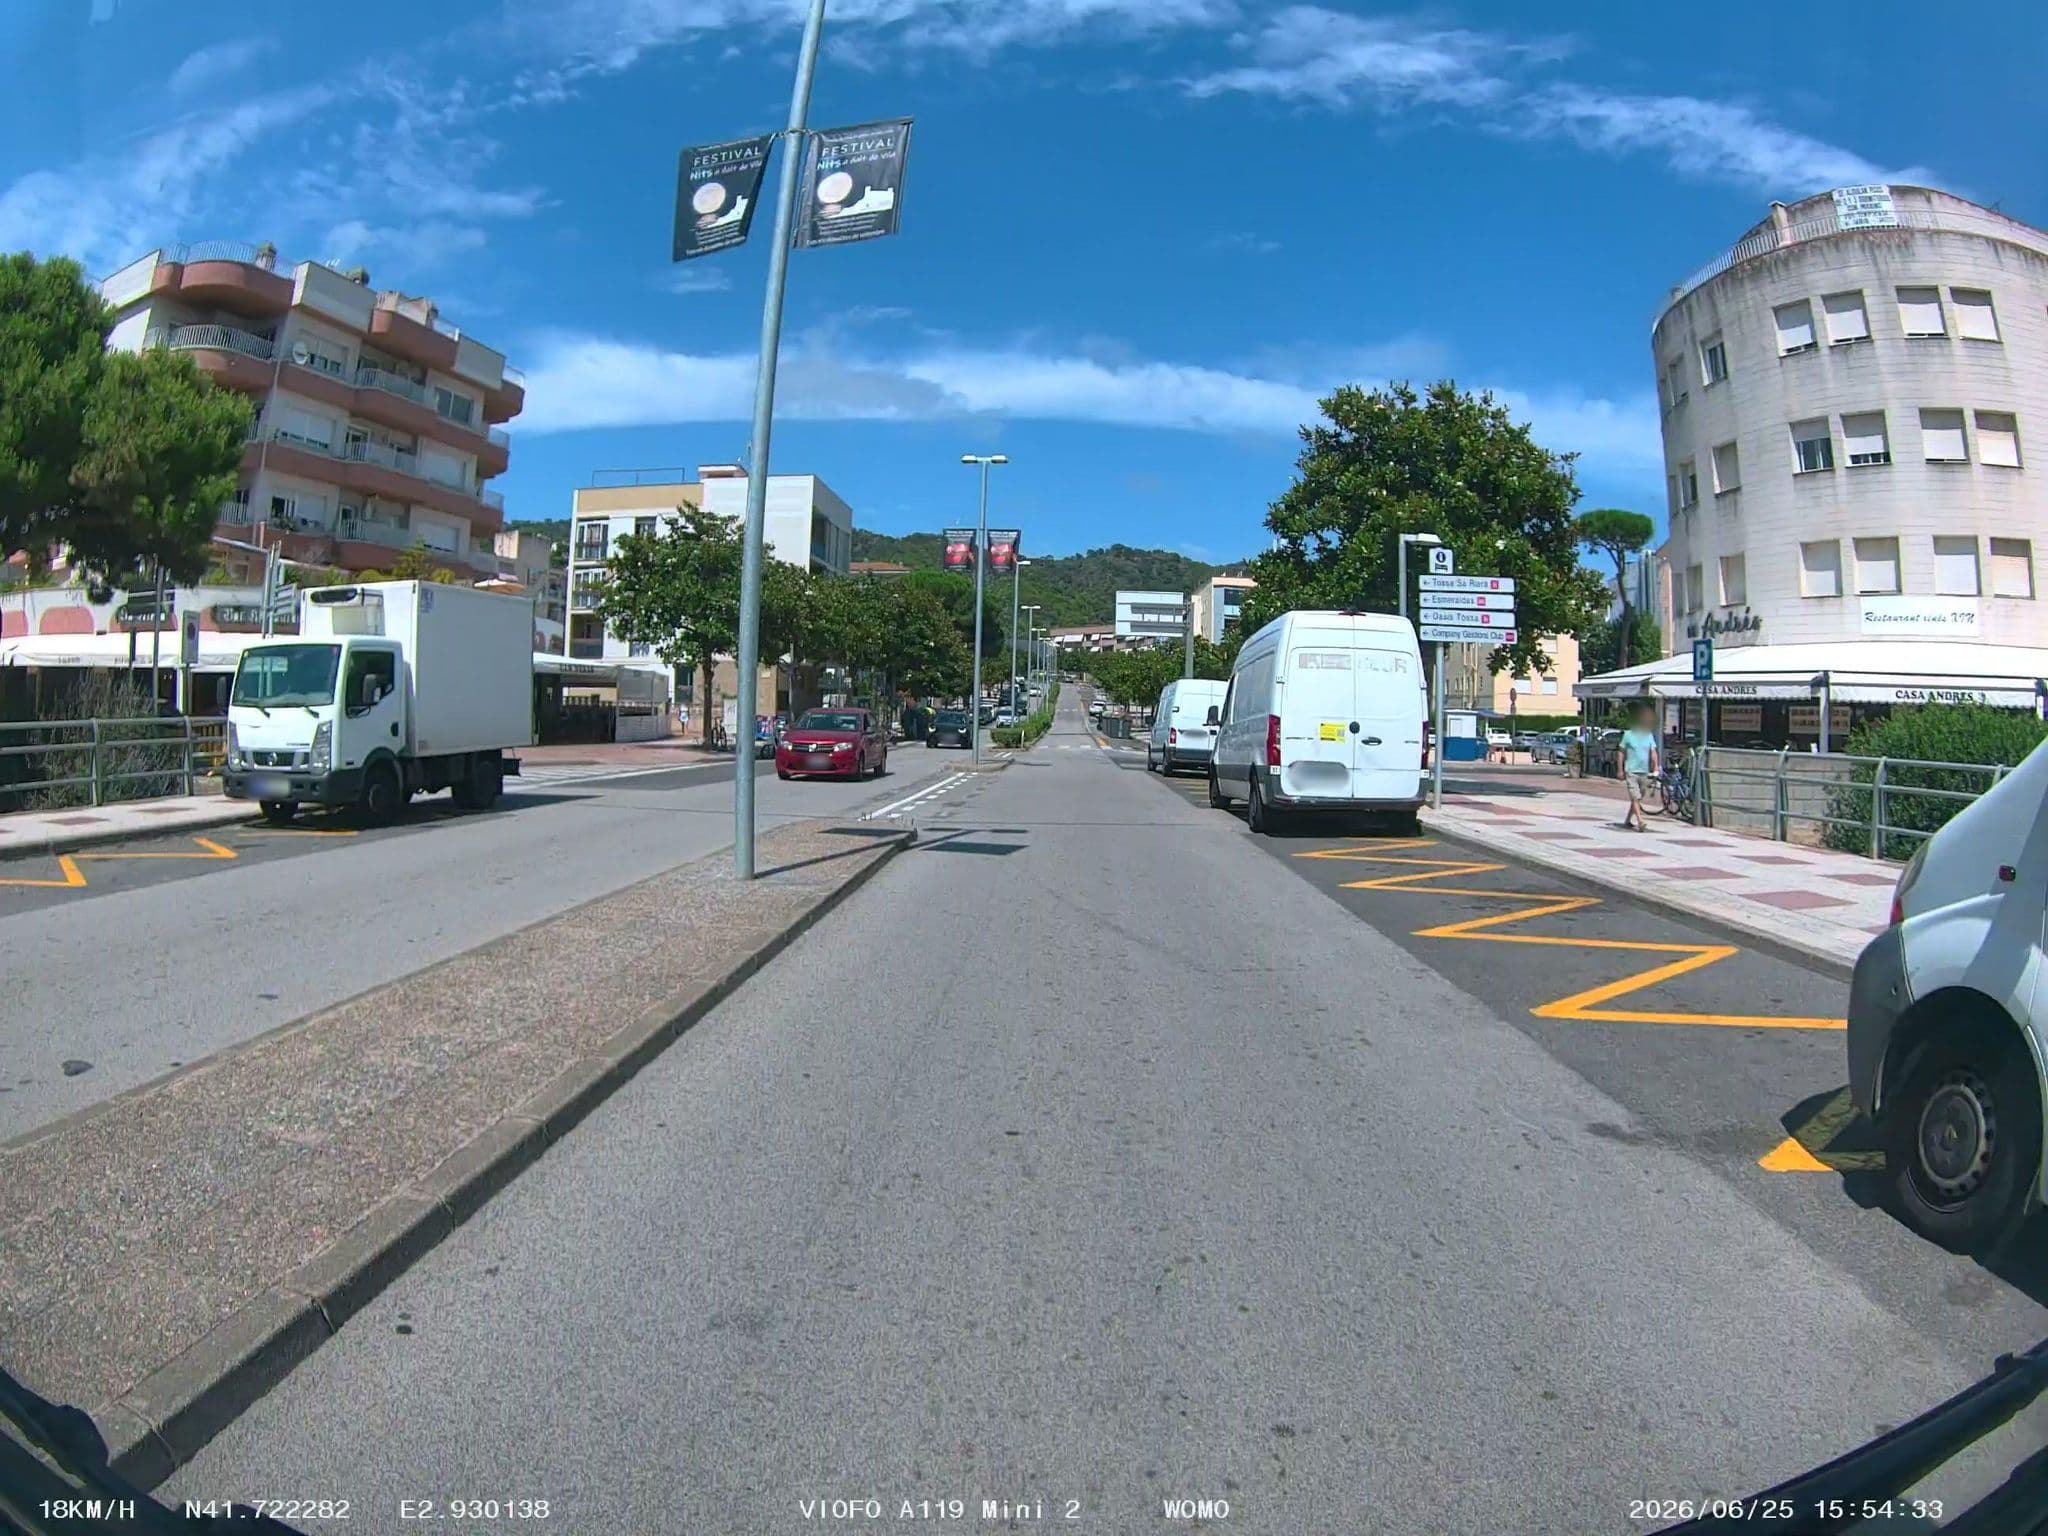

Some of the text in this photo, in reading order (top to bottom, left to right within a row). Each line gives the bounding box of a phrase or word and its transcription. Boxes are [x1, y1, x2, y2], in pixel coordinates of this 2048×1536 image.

[822, 137, 894, 157] FESTIVAL
[693, 145, 761, 167] FESTIVAL
[817, 159, 841, 170] Nits
[689, 168, 713, 182] Nits
[1864, 611, 1920, 623] Restaurant
[1695, 644, 1709, 677] P
[1720, 685, 1757, 695] ANDRES
[1895, 689, 1925, 700] CASA
[1927, 690, 1974, 702] ANDRES
